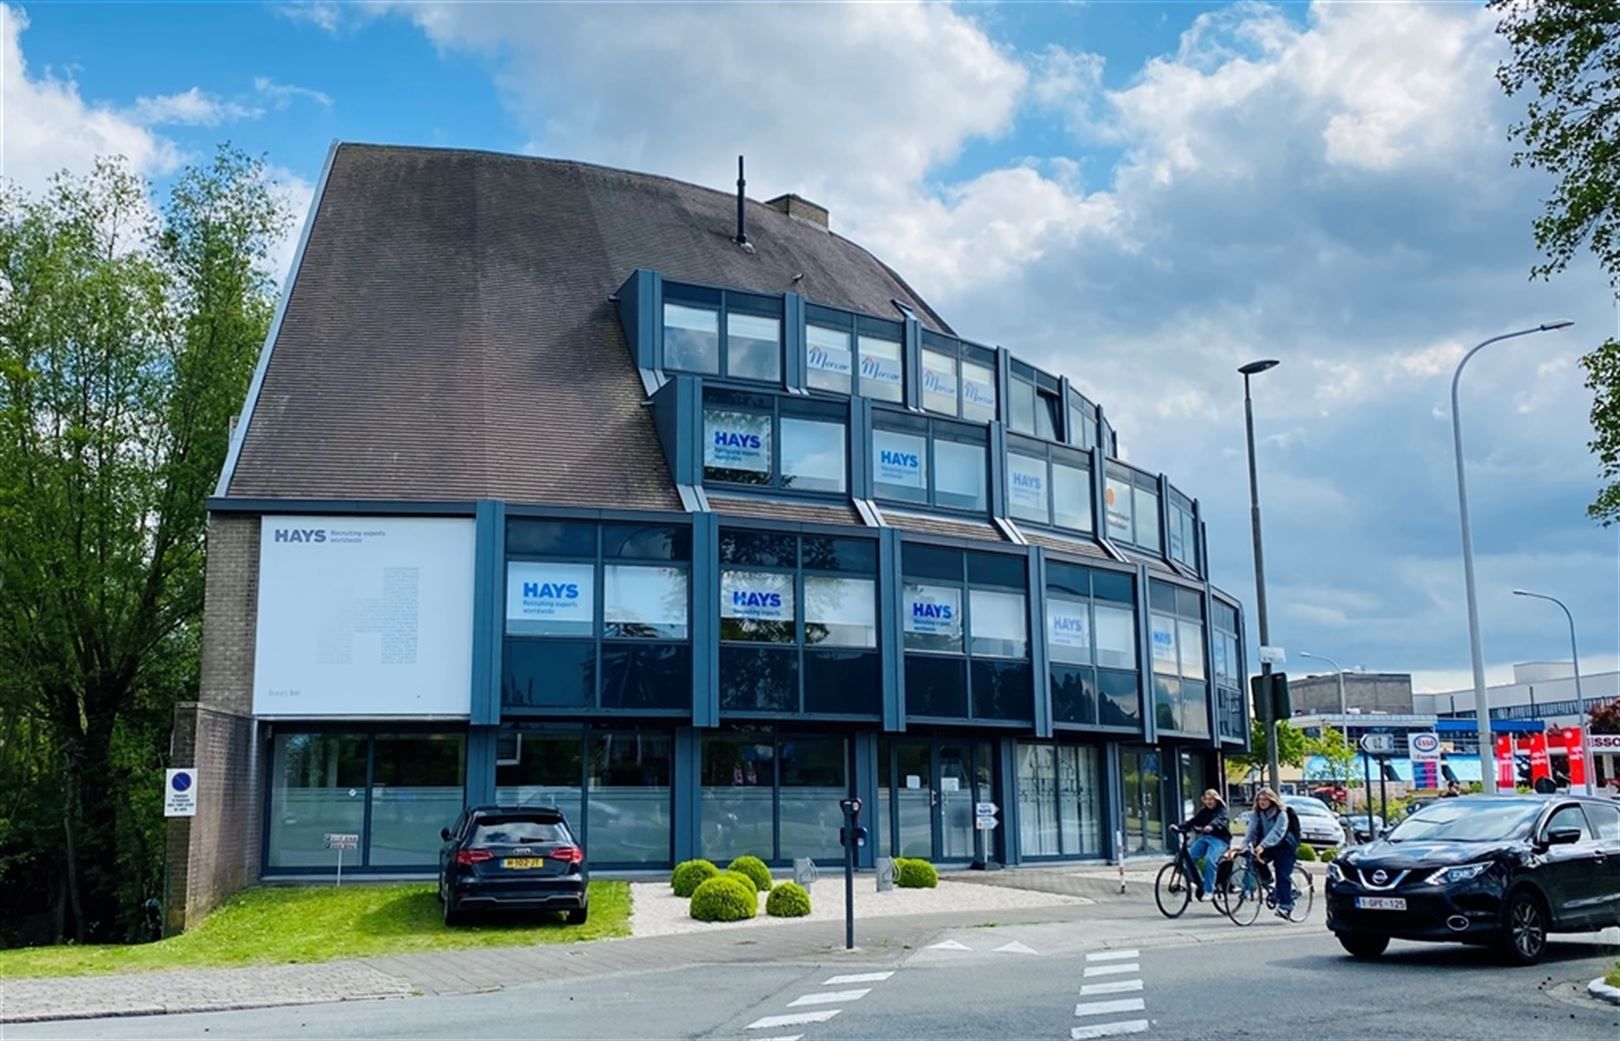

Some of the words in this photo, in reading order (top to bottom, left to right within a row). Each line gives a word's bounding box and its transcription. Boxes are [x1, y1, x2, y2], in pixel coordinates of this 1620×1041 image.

[714, 431, 761, 449] HAYS
[881, 450, 919, 468] HAYS
[1013, 472, 1042, 489] HAYS
[274, 528, 327, 543] HAYS
[523, 582, 579, 599] HAYS
[523, 599, 554, 608] Recruiting
[733, 591, 781, 608] HAYS
[913, 602, 952, 619] HAYS
[1054, 616, 1083, 632] HAYS
